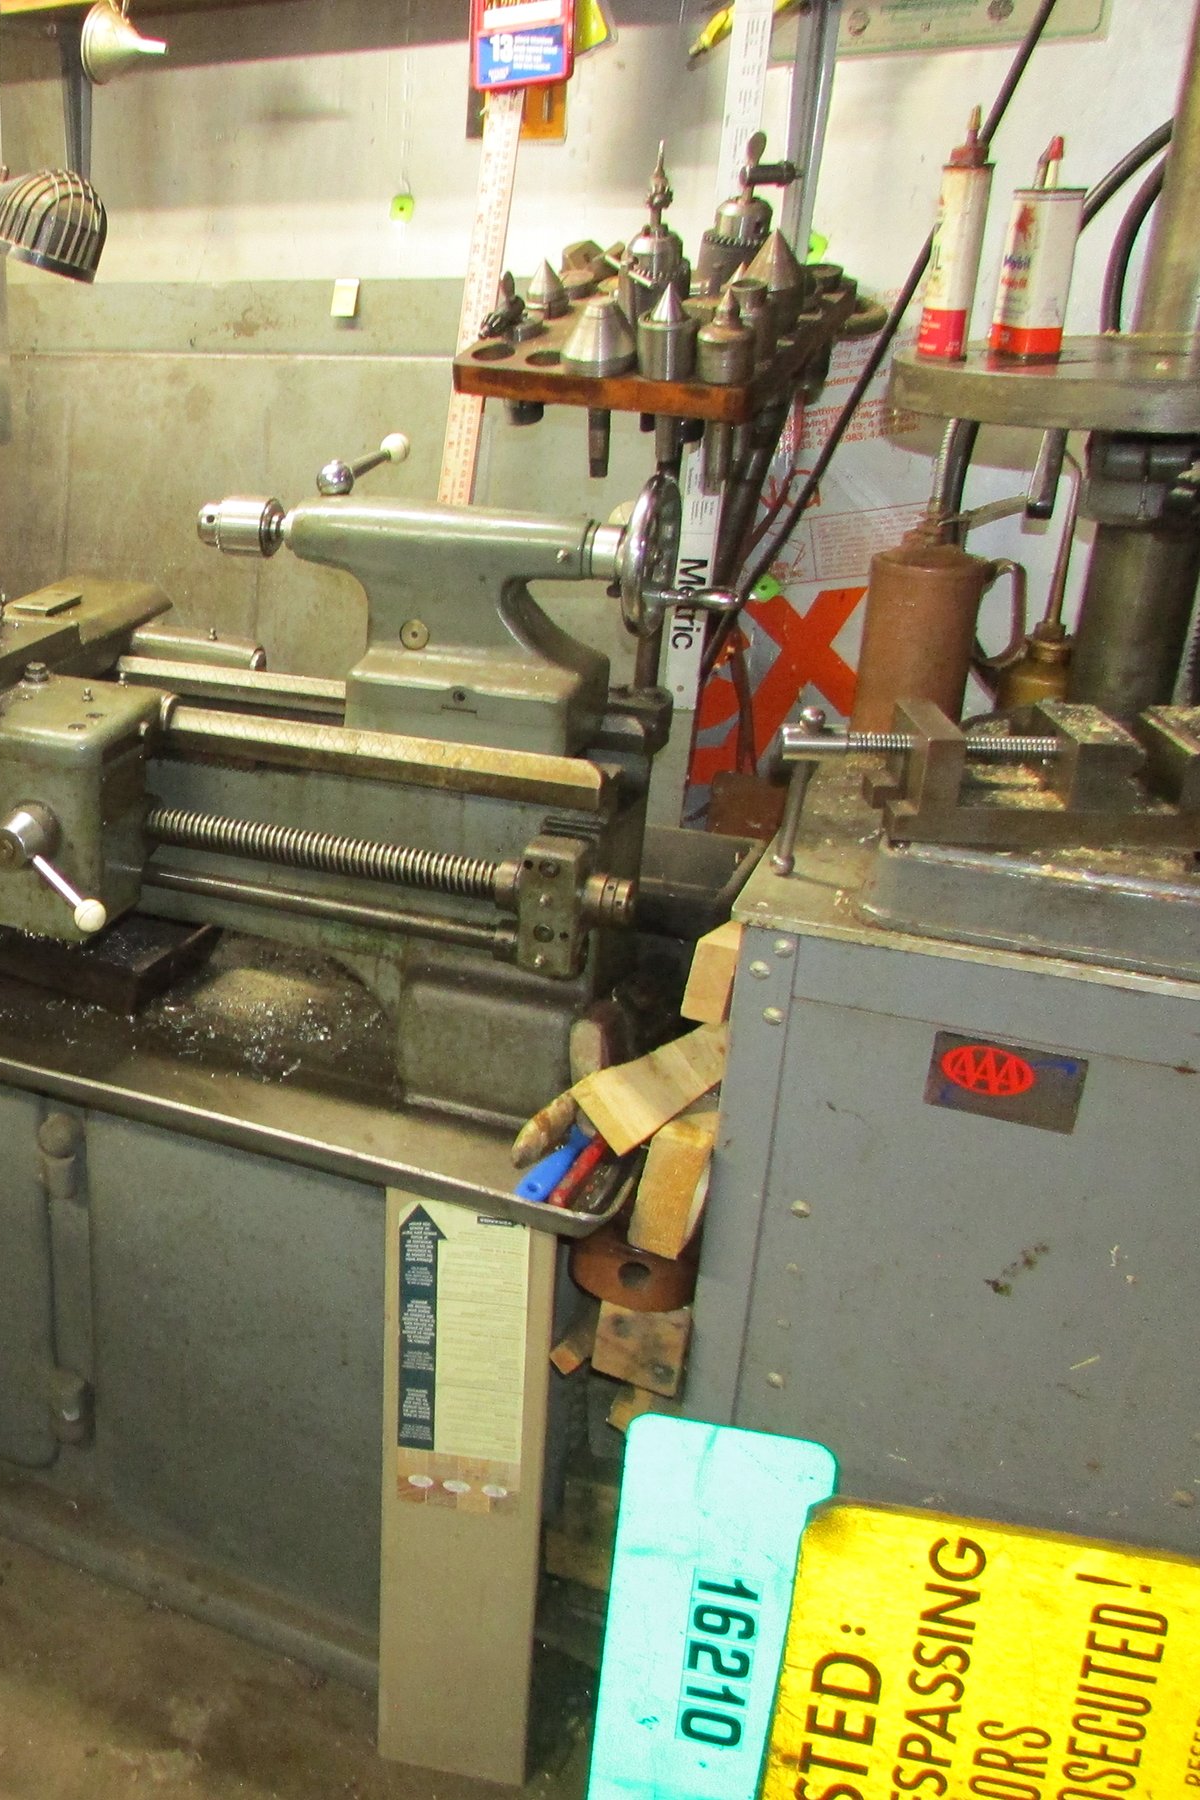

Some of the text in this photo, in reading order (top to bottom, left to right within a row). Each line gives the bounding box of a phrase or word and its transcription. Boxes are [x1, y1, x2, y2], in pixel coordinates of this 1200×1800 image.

[490, 34, 514, 63] 13
[945, 1047, 1029, 1095] AAA
[681, 1576, 759, 1748] 16210
